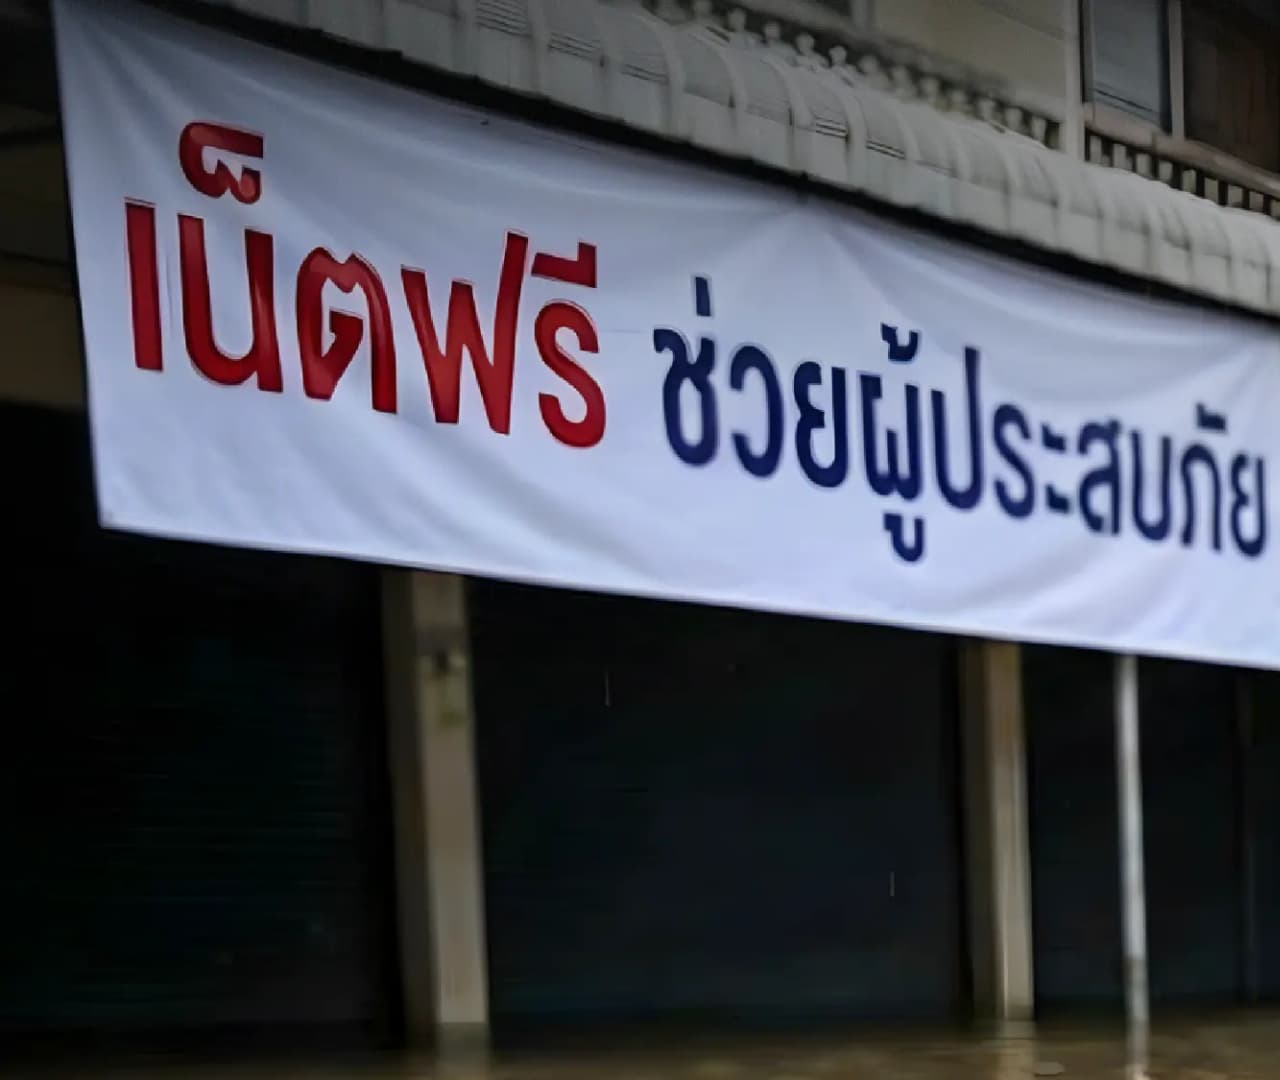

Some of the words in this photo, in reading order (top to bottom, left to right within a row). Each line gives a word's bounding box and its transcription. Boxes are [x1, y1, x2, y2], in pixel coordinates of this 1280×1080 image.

[125, 121, 607, 448] เน็ตฟรี
[652, 275, 1267, 564] ช่วยผู้ประสบภัย
